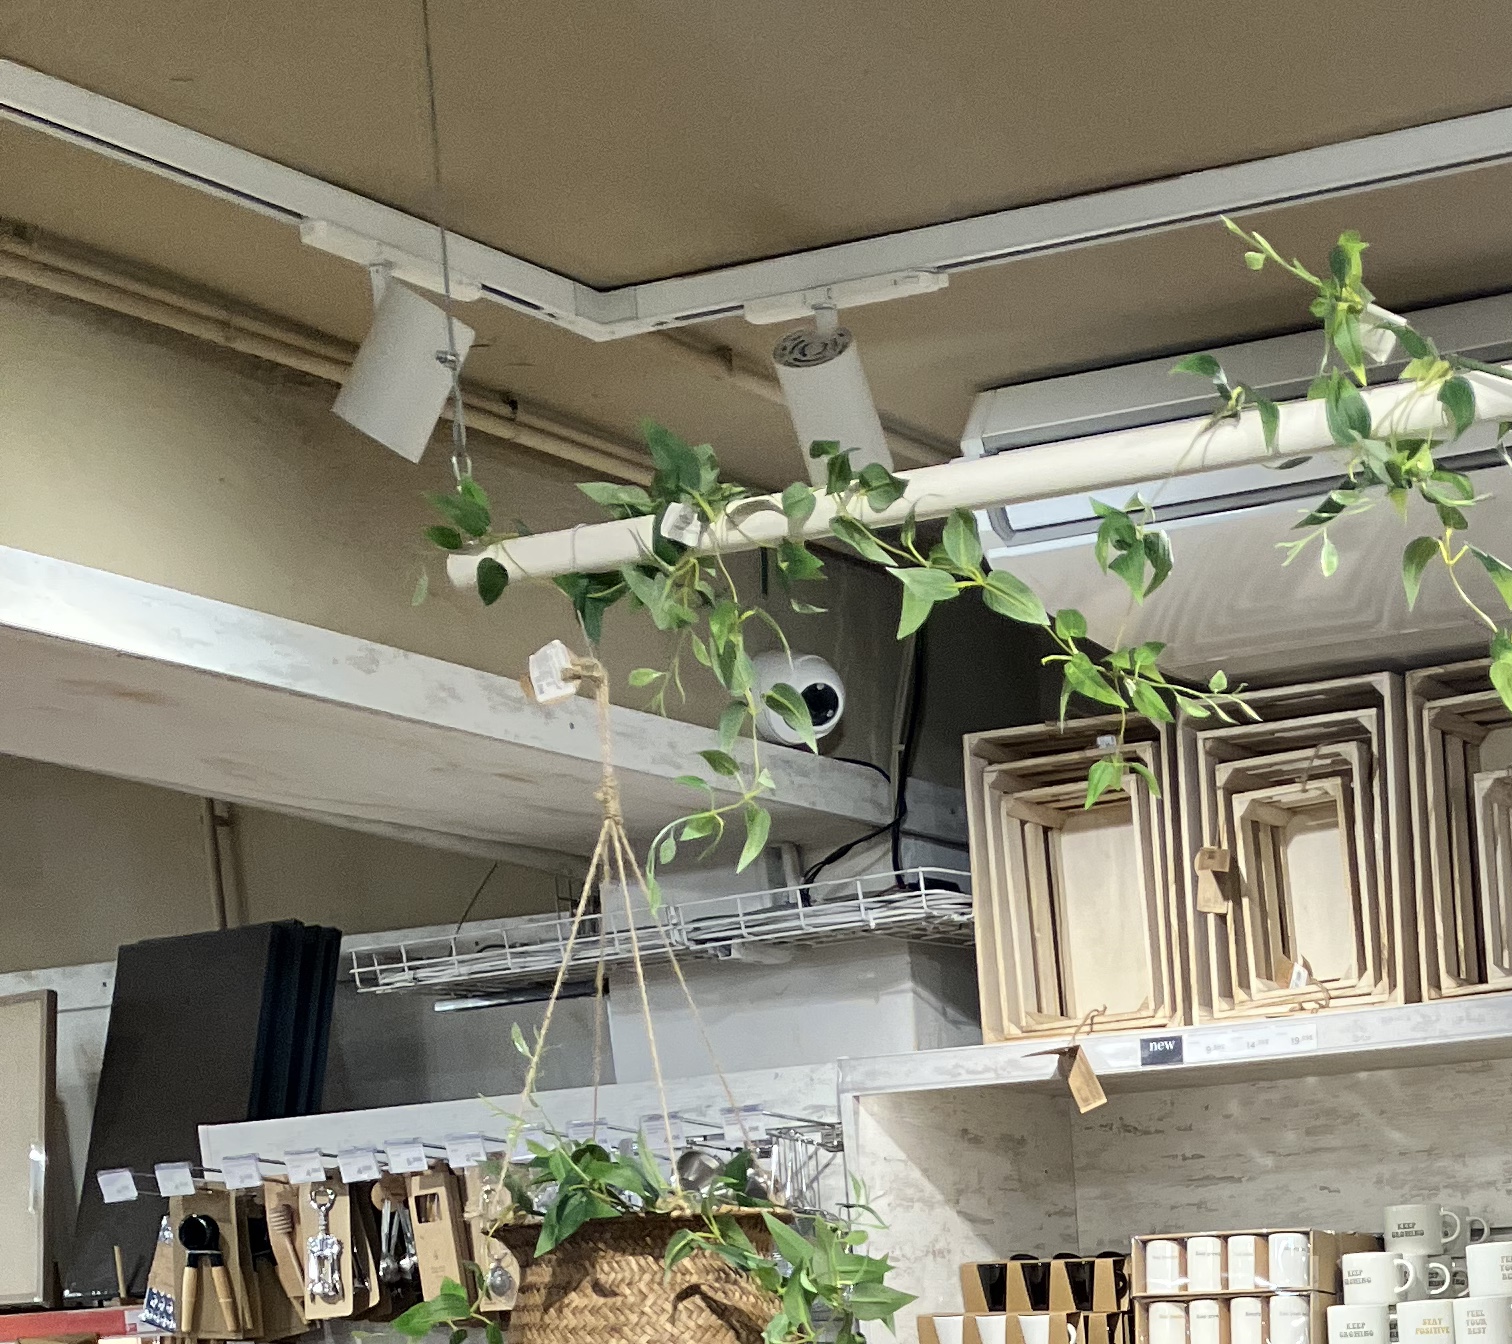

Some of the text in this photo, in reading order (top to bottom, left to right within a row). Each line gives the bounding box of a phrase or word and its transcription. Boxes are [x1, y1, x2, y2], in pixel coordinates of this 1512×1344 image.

[1149, 1039, 1176, 1052] new
[1466, 1309, 1486, 1318] FEEL
[1422, 1318, 1443, 1327] STAY
[1466, 1318, 1488, 1327] YOUR
[1415, 1326, 1450, 1335] POSITIVE
[1467, 1326, 1487, 1335] BEST
